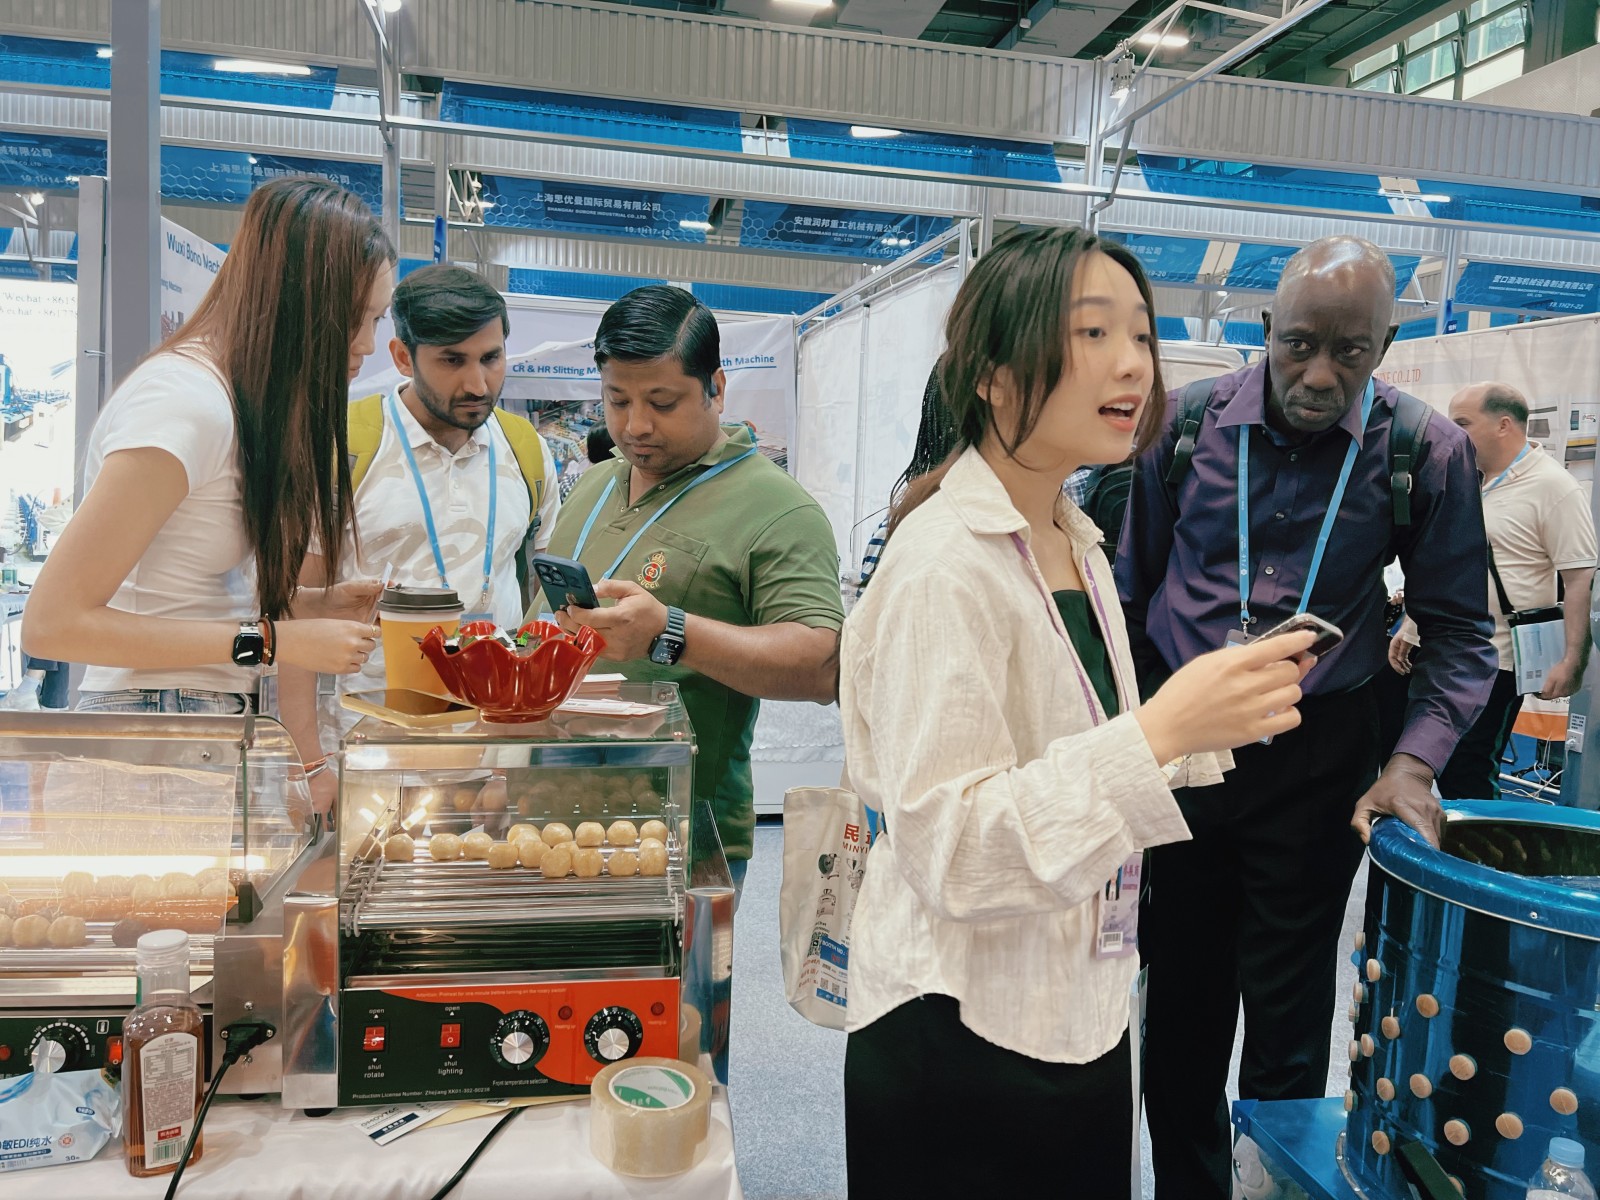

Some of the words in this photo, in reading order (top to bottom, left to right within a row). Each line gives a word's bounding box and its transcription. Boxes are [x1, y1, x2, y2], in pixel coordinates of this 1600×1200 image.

[534, 192, 661, 213] 上海思优曼国际贸易有限公司
[794, 216, 901, 233] 安徽润邦重工机械有限公司
[624, 226, 671, 236] 19.1H17-18
[166, 231, 186, 257] Wuxi
[735, 354, 775, 366] Machine
[527, 364, 535, 373] &
[537, 365, 551, 374] HR
[552, 366, 584, 376] Slitting
[445, 1005, 460, 1013] open
[437, 1067, 464, 1076] lighting
[352, 1092, 381, 1100] Production
